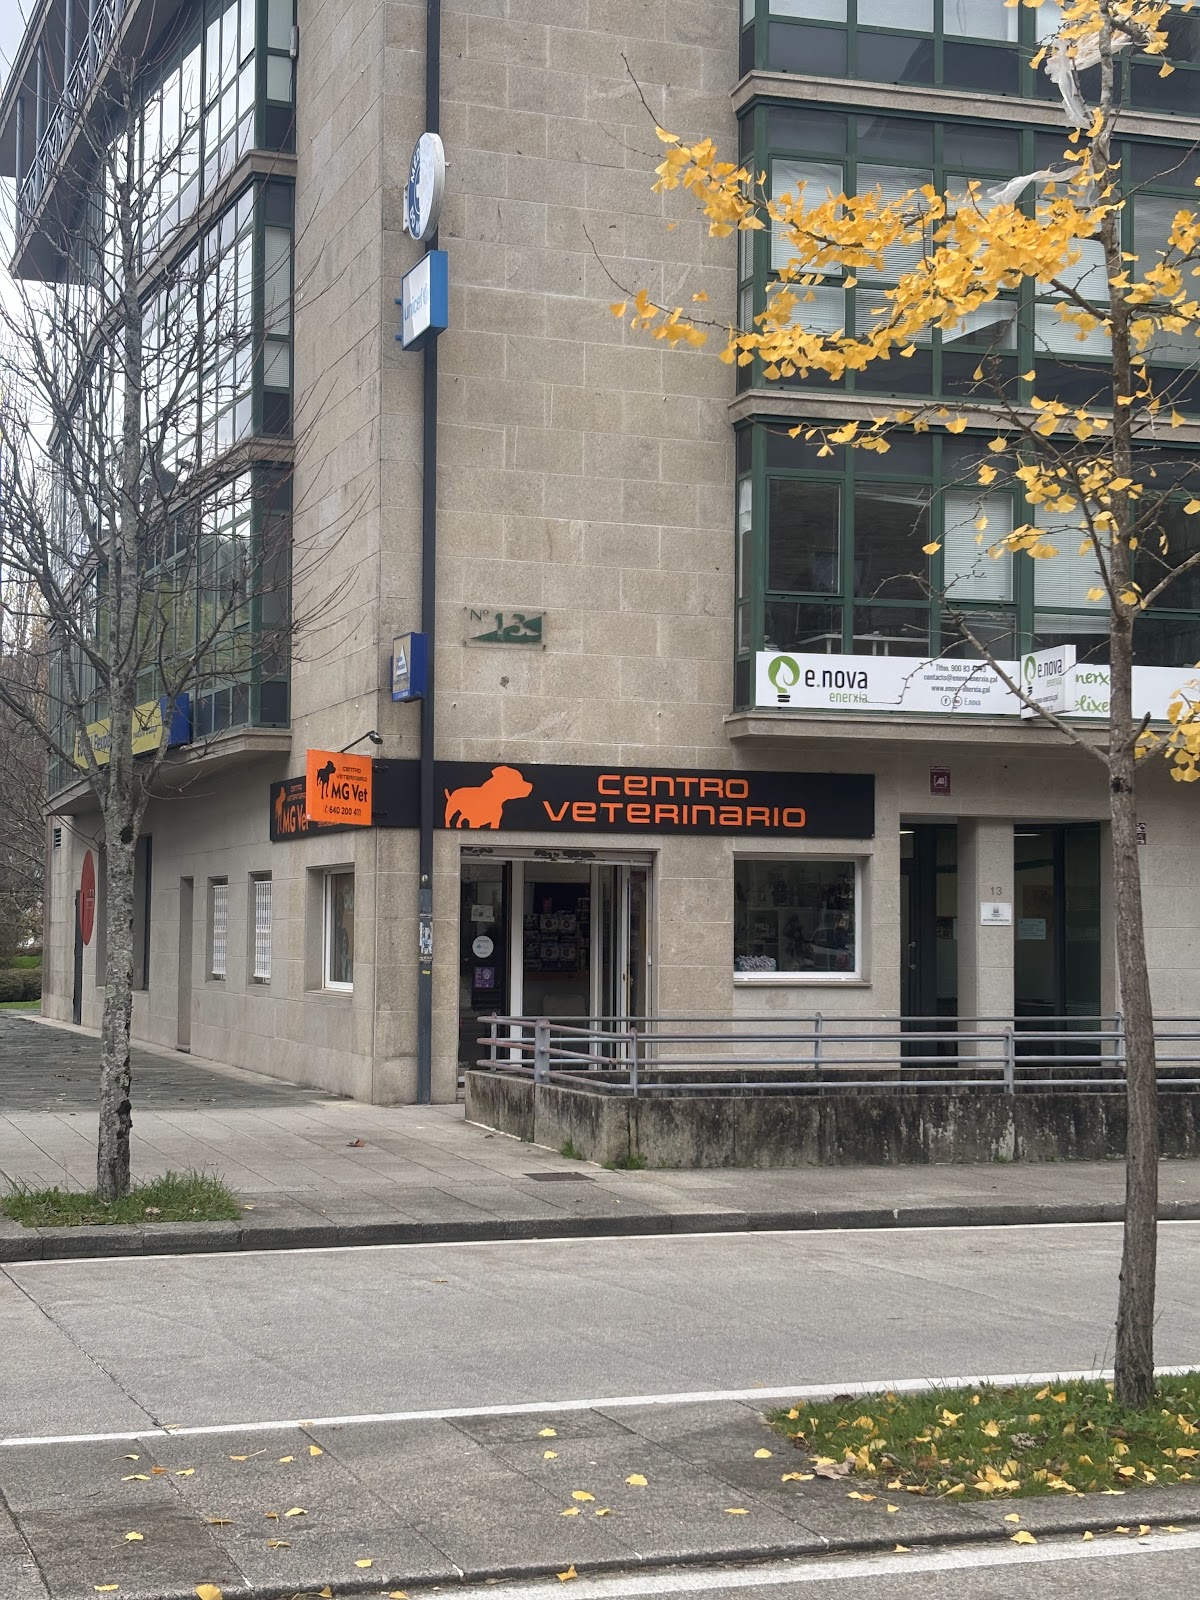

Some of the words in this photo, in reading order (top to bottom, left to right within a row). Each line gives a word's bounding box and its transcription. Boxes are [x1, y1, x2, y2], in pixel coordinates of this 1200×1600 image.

[404, 287, 423, 321] unicef
[951, 664, 962, 672] 900
[963, 665, 970, 673] 83
[1037, 658, 1062, 678] e.nova
[804, 669, 868, 689] e.nova
[1075, 671, 1110, 686] nerx
[331, 781, 350, 801] MG
[351, 784, 368, 803] Vet
[282, 804, 296, 833] MG
[329, 805, 340, 815] 640
[341, 806, 352, 816] 200
[990, 886, 1003, 896] 13
